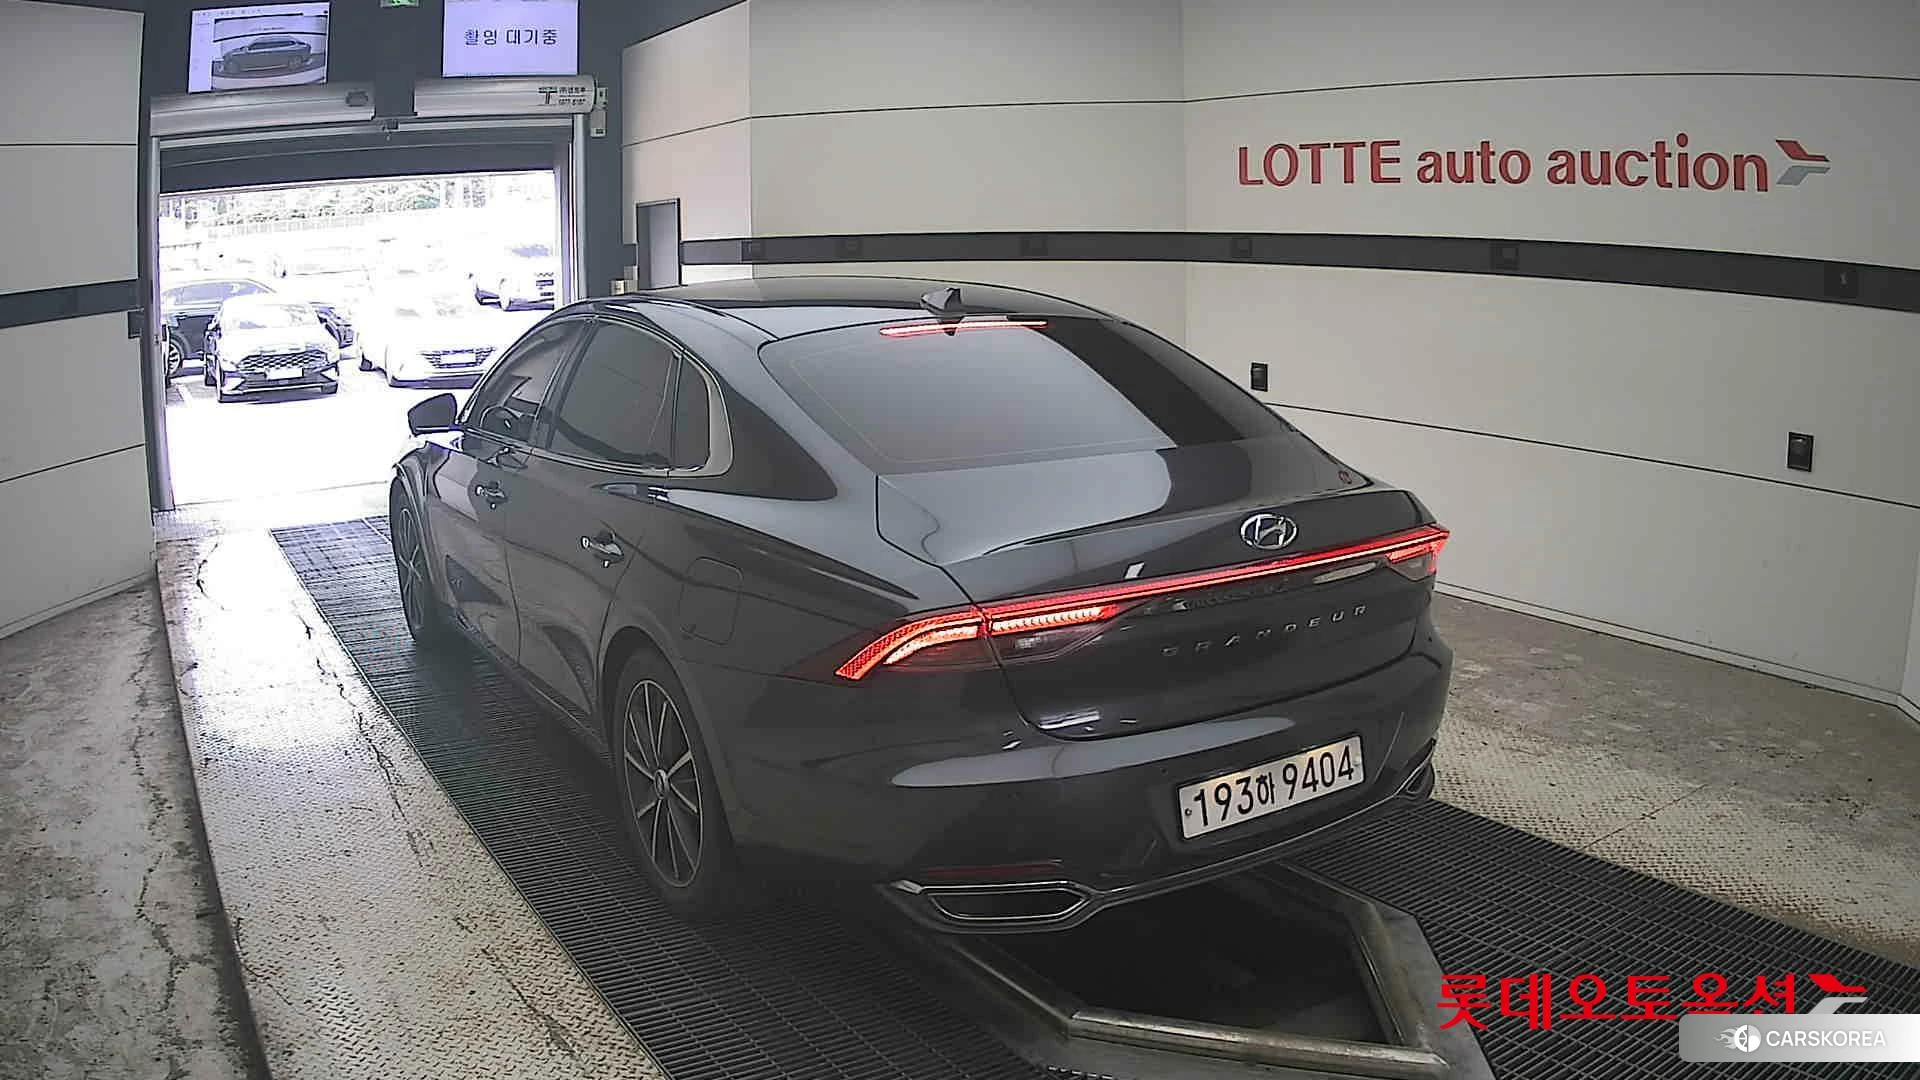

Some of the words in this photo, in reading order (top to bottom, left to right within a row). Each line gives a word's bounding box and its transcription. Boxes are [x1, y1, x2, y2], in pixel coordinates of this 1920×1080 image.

[506, 28, 558, 46] 대기중
[1238, 140, 1401, 188] LOTTE
[1416, 140, 1532, 185] auto
[1547, 132, 1769, 192] auction
[1161, 604, 1367, 657] GRANDEUR
[1282, 744, 1355, 801] 9404
